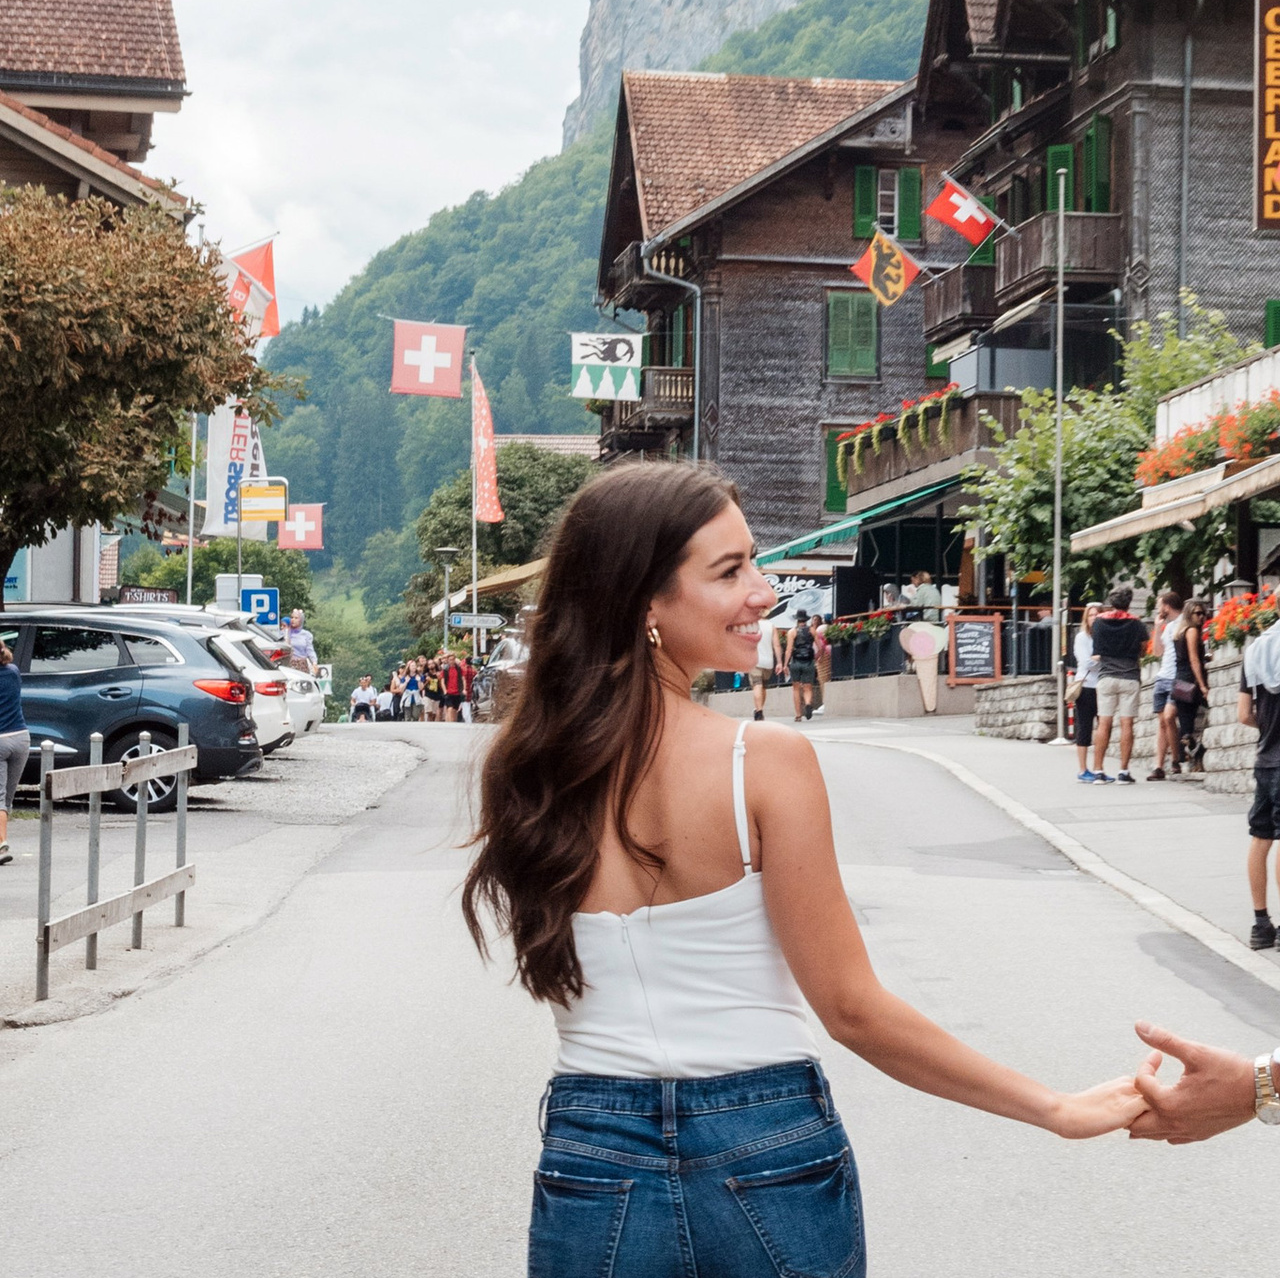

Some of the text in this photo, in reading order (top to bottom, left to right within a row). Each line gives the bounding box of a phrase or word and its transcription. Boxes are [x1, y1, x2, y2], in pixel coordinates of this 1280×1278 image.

[763, 574, 821, 593] Coffee
[125, 592, 169, 602] T-SHIRTS
[251, 594, 270, 619] P
